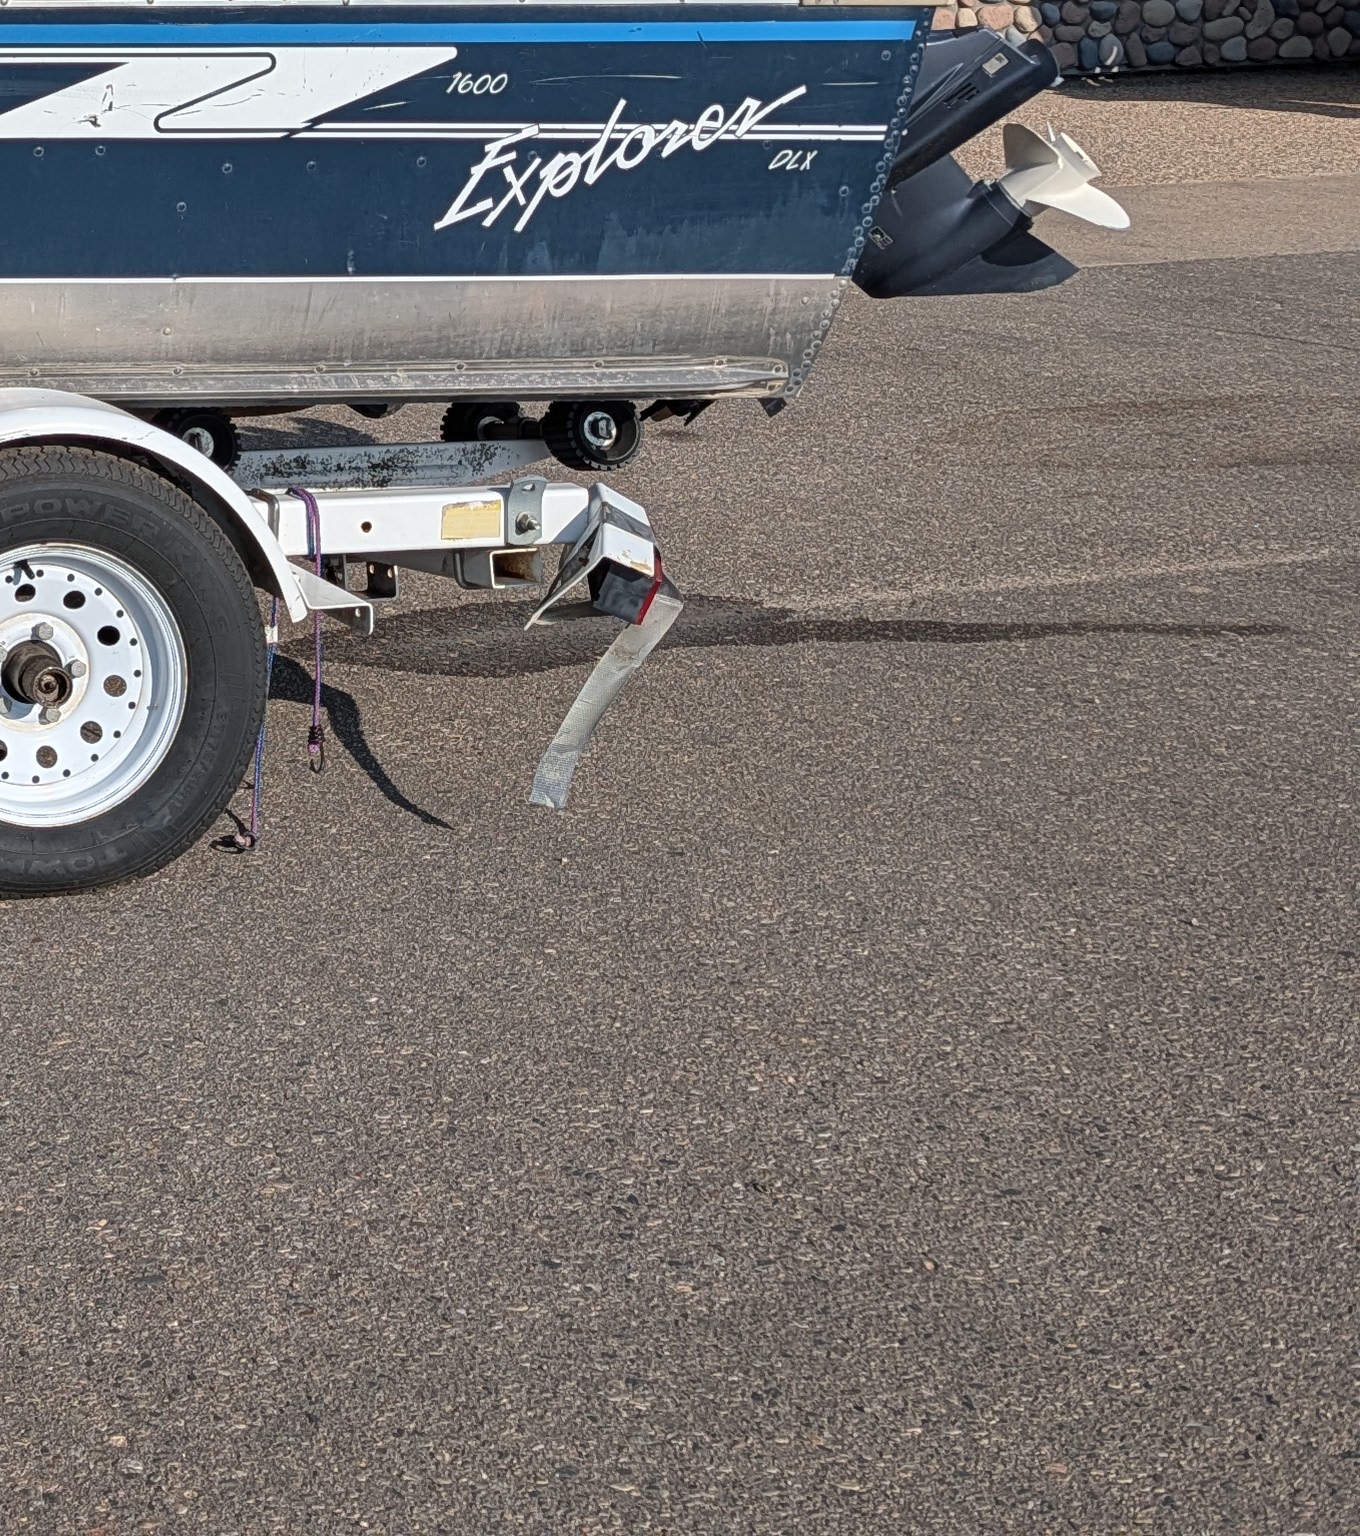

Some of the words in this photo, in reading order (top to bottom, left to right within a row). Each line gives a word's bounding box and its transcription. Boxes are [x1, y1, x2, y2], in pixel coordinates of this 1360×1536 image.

[446, 72, 508, 95] 1600
[433, 85, 807, 233] Explorer
[768, 149, 818, 171] DLX
